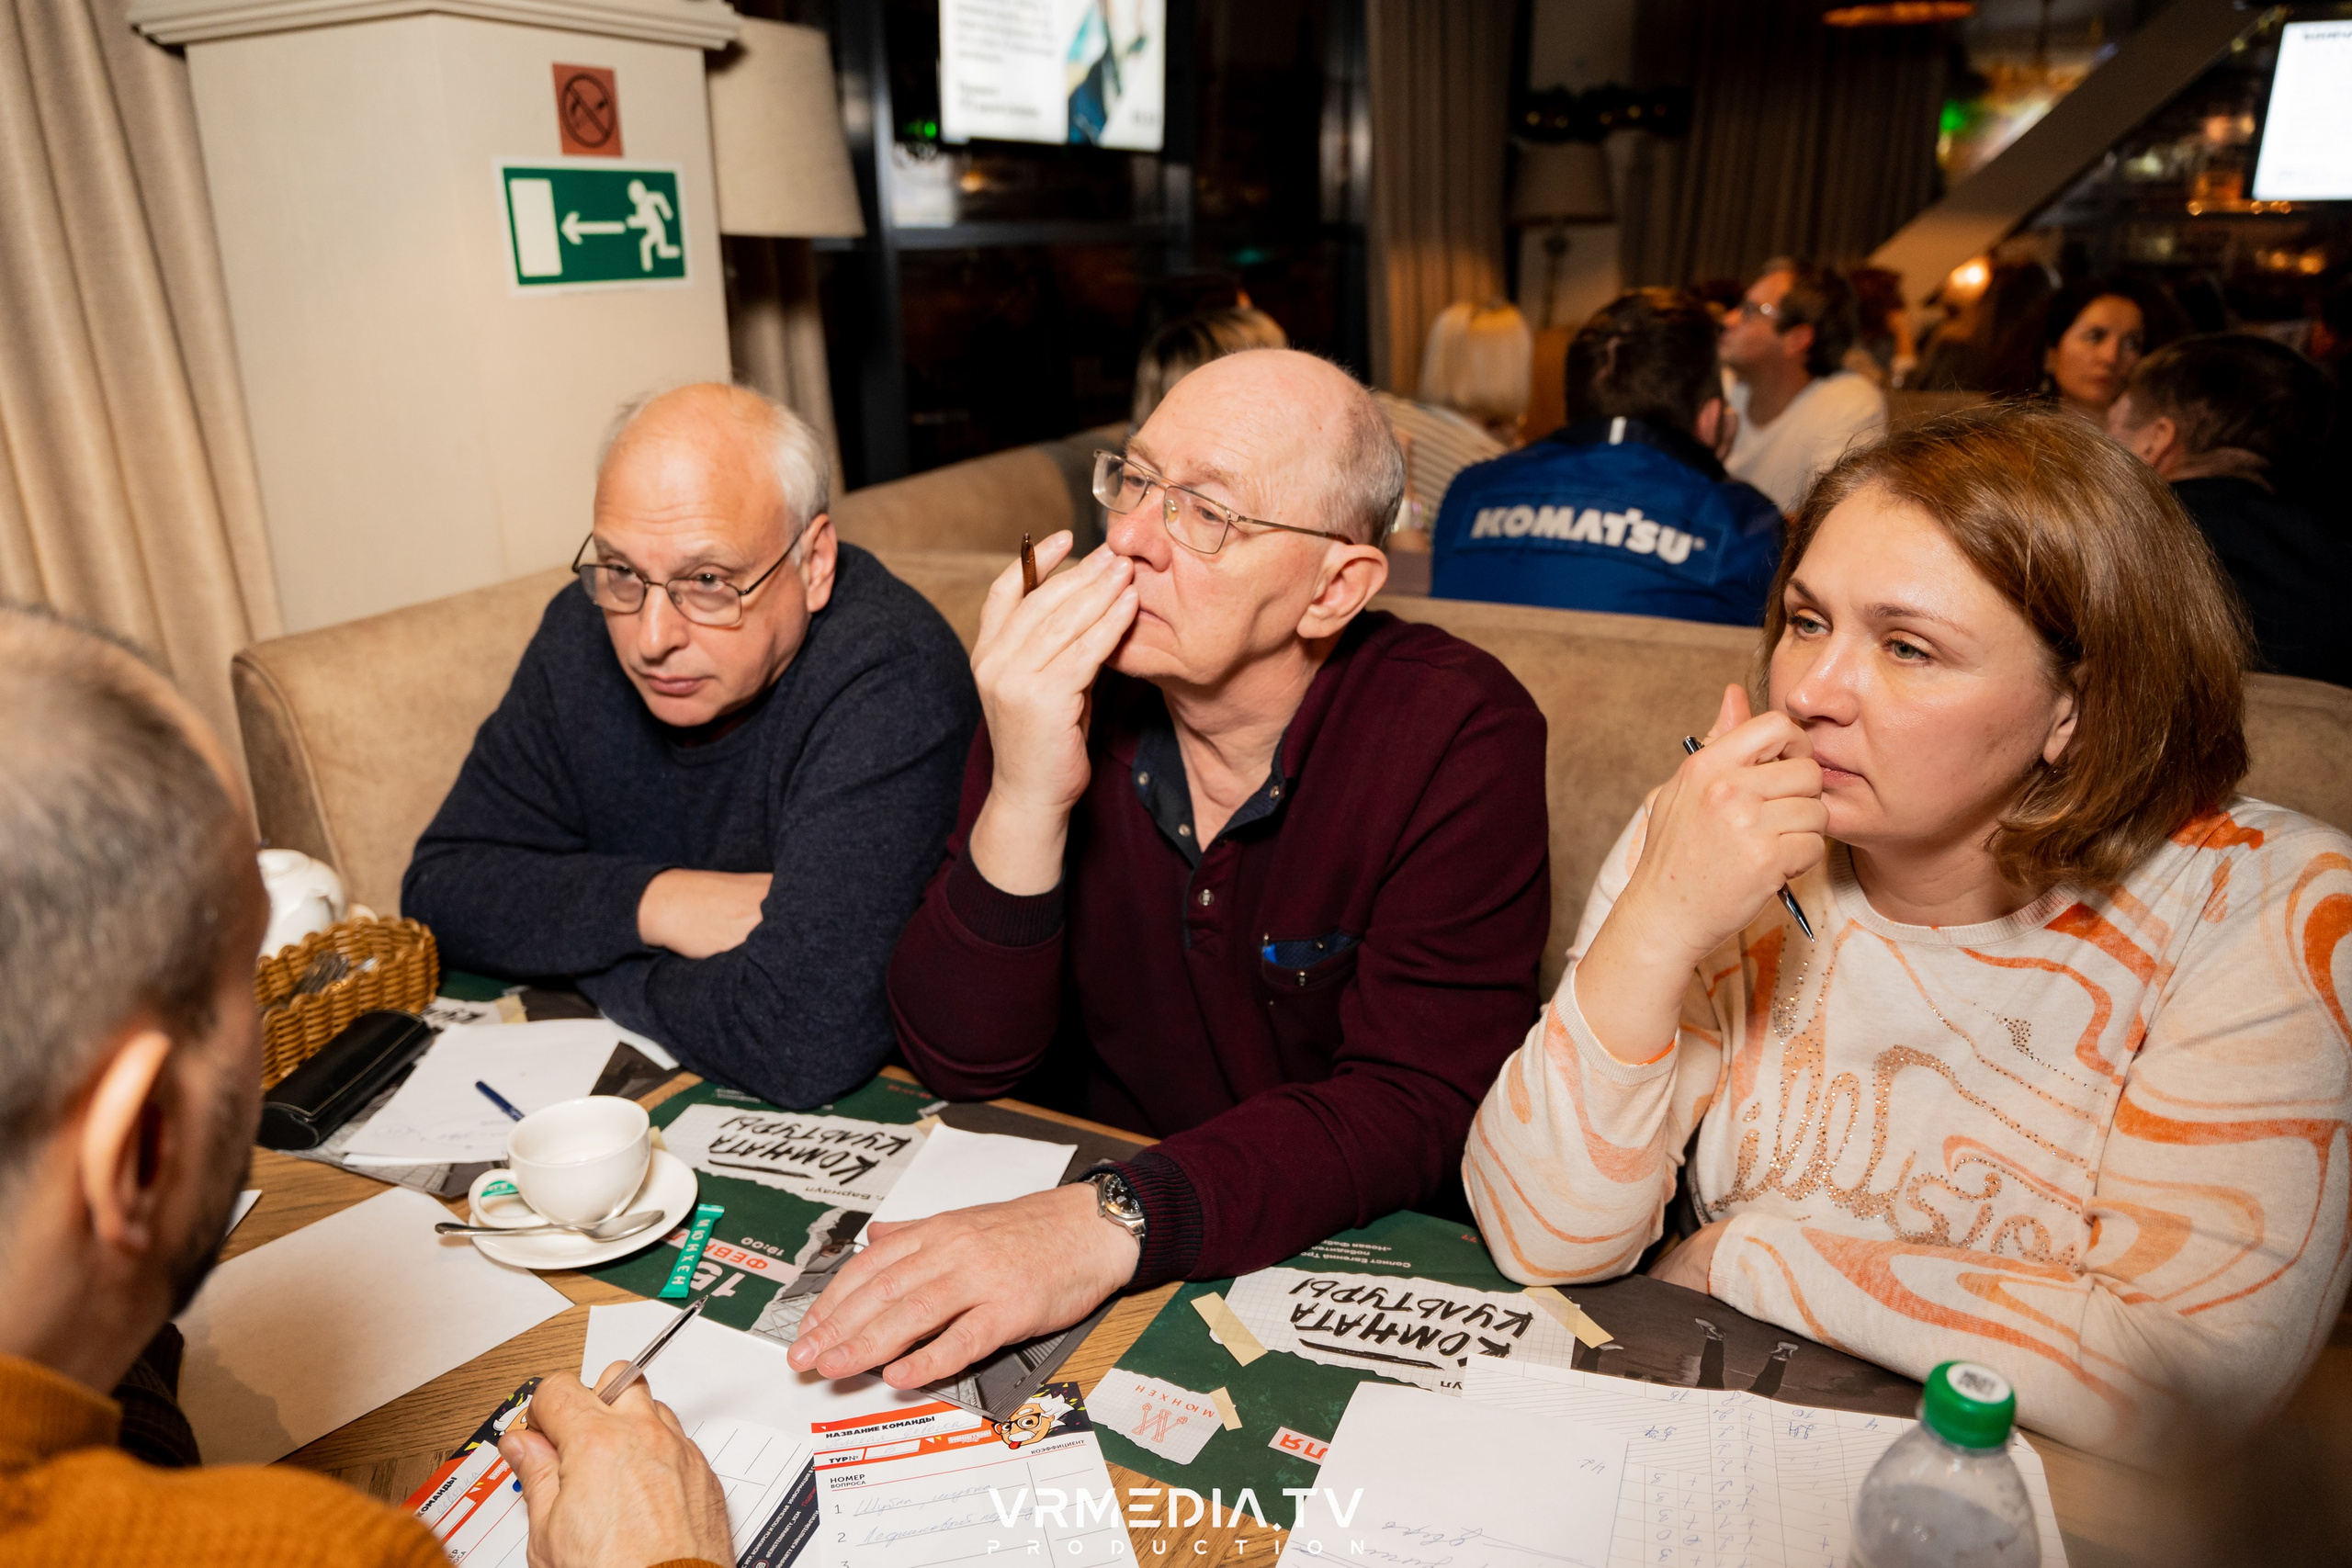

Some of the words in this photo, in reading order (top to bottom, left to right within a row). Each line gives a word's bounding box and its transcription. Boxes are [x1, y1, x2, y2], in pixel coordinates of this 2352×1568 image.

[718, 1115, 912, 1157] КУЛЬТУРЫ
[707, 1134, 880, 1186] КОМНАТА
[672, 1219, 711, 1285] МЮНХЕН
[741, 1236, 785, 1258] 19:00
[1309, 1246, 1371, 1257] победител
[689, 1260, 746, 1297] 15
[1288, 1278, 1534, 1339] КУЛЬТУРЫ
[1134, 1384, 1216, 1418] МЮНХЕН
[826, 1425, 881, 1438] НАЗВАНИЕ
[882, 1416, 935, 1431] КОМАНДЫ
[1031, 1439, 1086, 1454] КОЭФФИЦИЕНТ
[1279, 1434, 1329, 1460] ЛЯ
[830, 1473, 865, 1483] НОМЕР
[831, 1480, 866, 1489] ВОПРОСА
[834, 1504, 842, 1514] 1
[837, 1532, 846, 1543] 2
